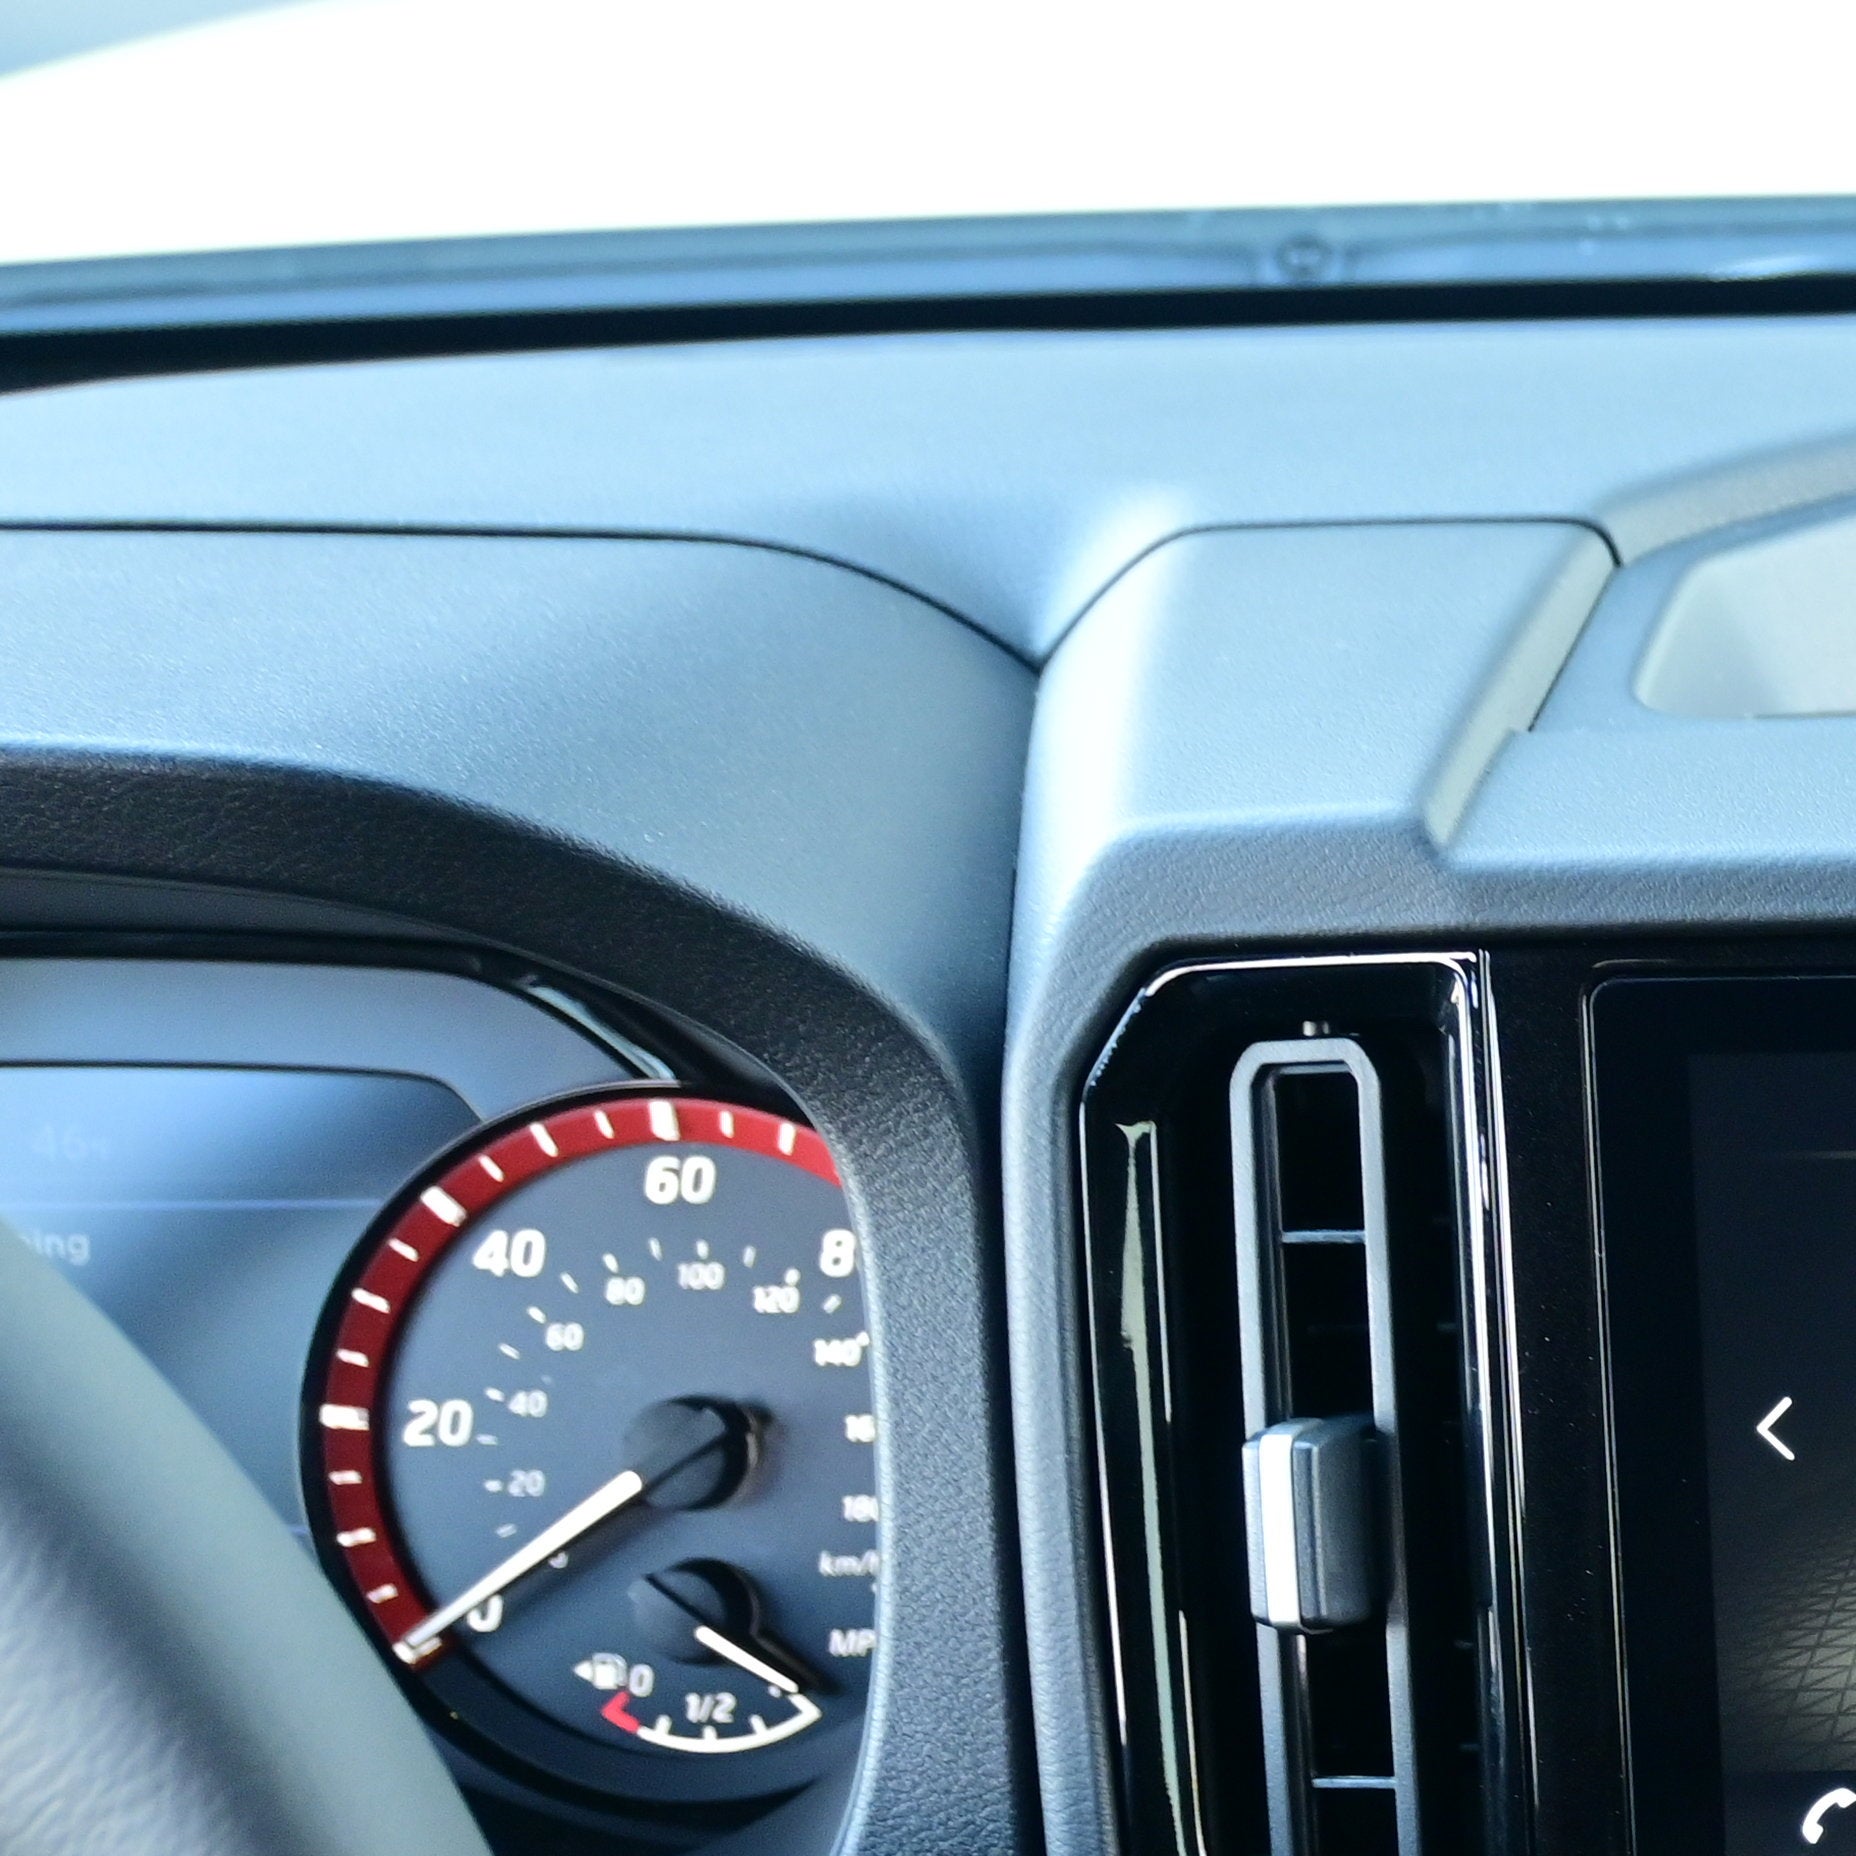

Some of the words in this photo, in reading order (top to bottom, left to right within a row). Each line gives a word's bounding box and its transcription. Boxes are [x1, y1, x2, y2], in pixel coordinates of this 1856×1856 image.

[643, 1154, 716, 1204] 60
[20, 1228, 91, 1266] ing
[472, 1228, 546, 1278] 40
[818, 1228, 858, 1278] 8
[604, 1276, 646, 1306] 80
[677, 1261, 726, 1290] 100
[753, 1286, 801, 1314] 120
[544, 1321, 585, 1352] 60
[508, 1389, 549, 1419] 40
[402, 1399, 475, 1448] 20
[507, 1469, 547, 1498] 20
[828, 1628, 877, 1658] MP
[684, 1691, 737, 1724] 1/2
